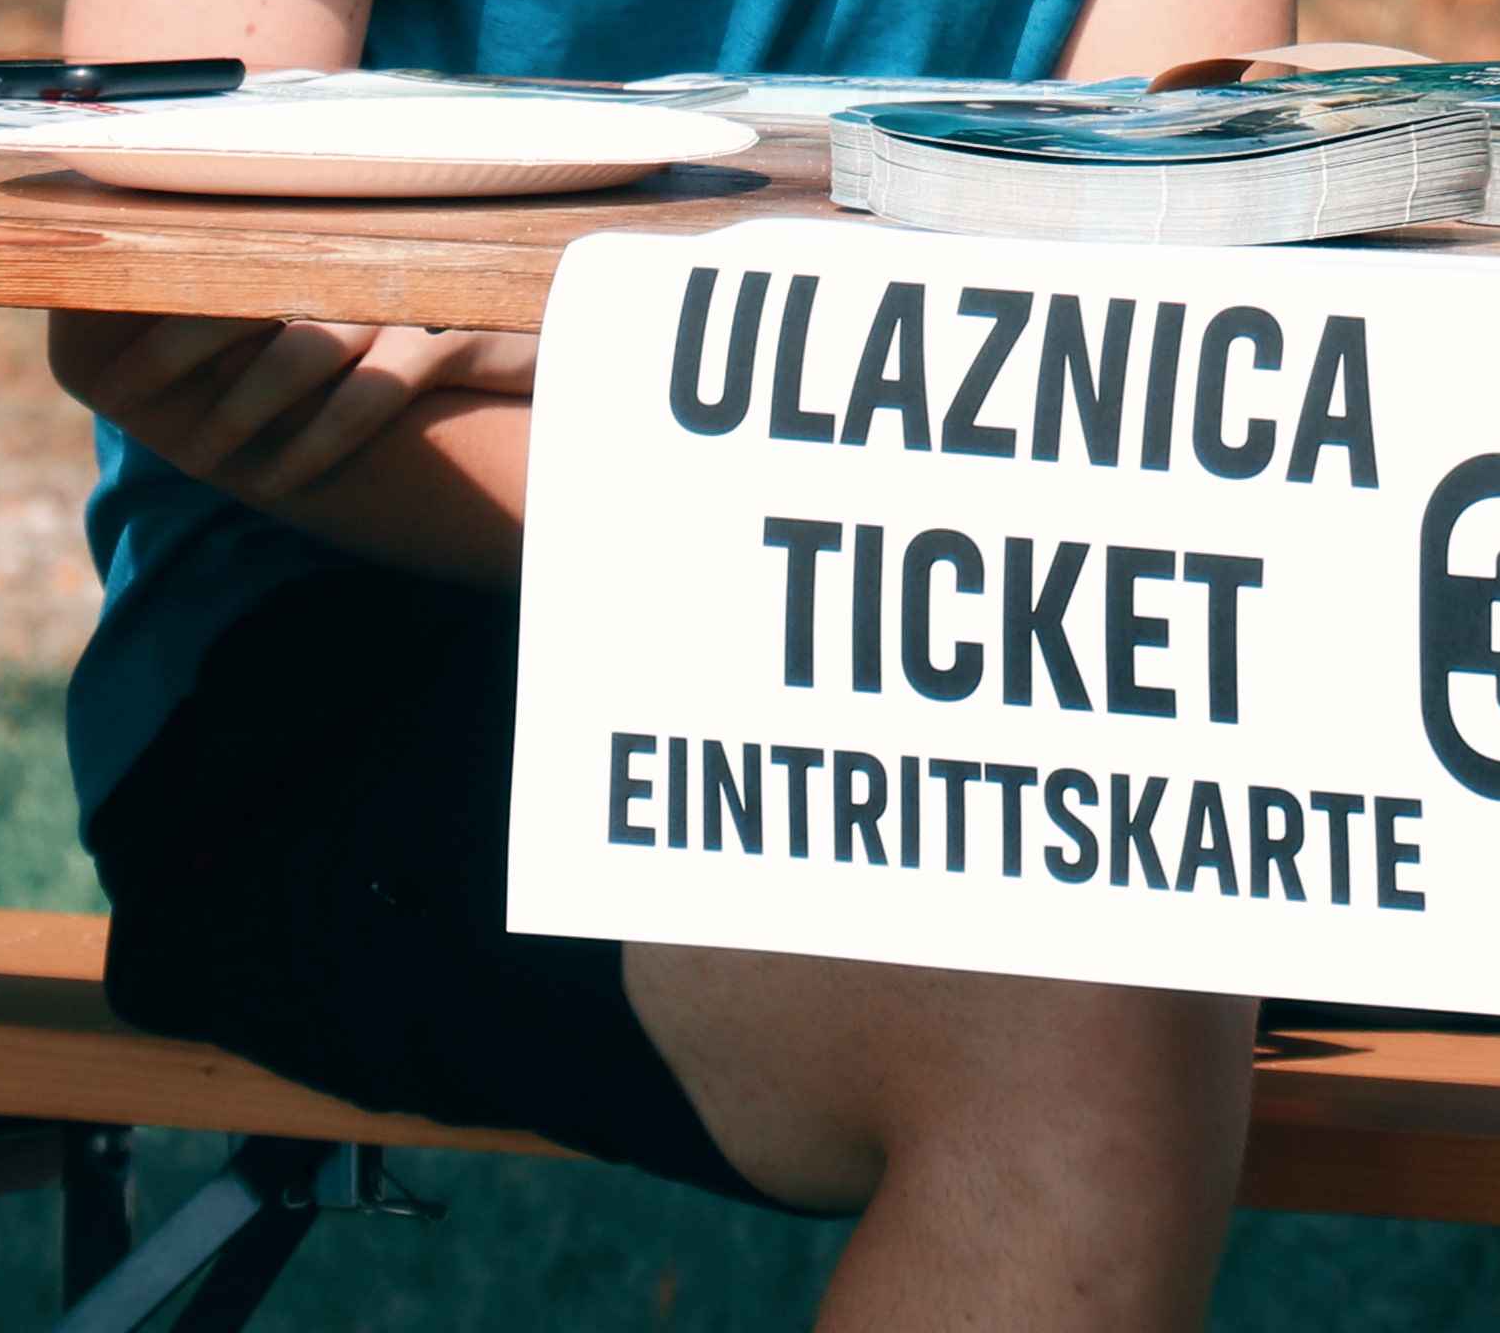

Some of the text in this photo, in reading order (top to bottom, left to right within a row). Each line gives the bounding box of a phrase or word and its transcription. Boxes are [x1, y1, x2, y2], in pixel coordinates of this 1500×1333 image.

[670, 268, 1379, 488] ULAZNICA
[764, 517, 1263, 725] TICKET
[609, 733, 1426, 912] EINTRITTSKARTE
